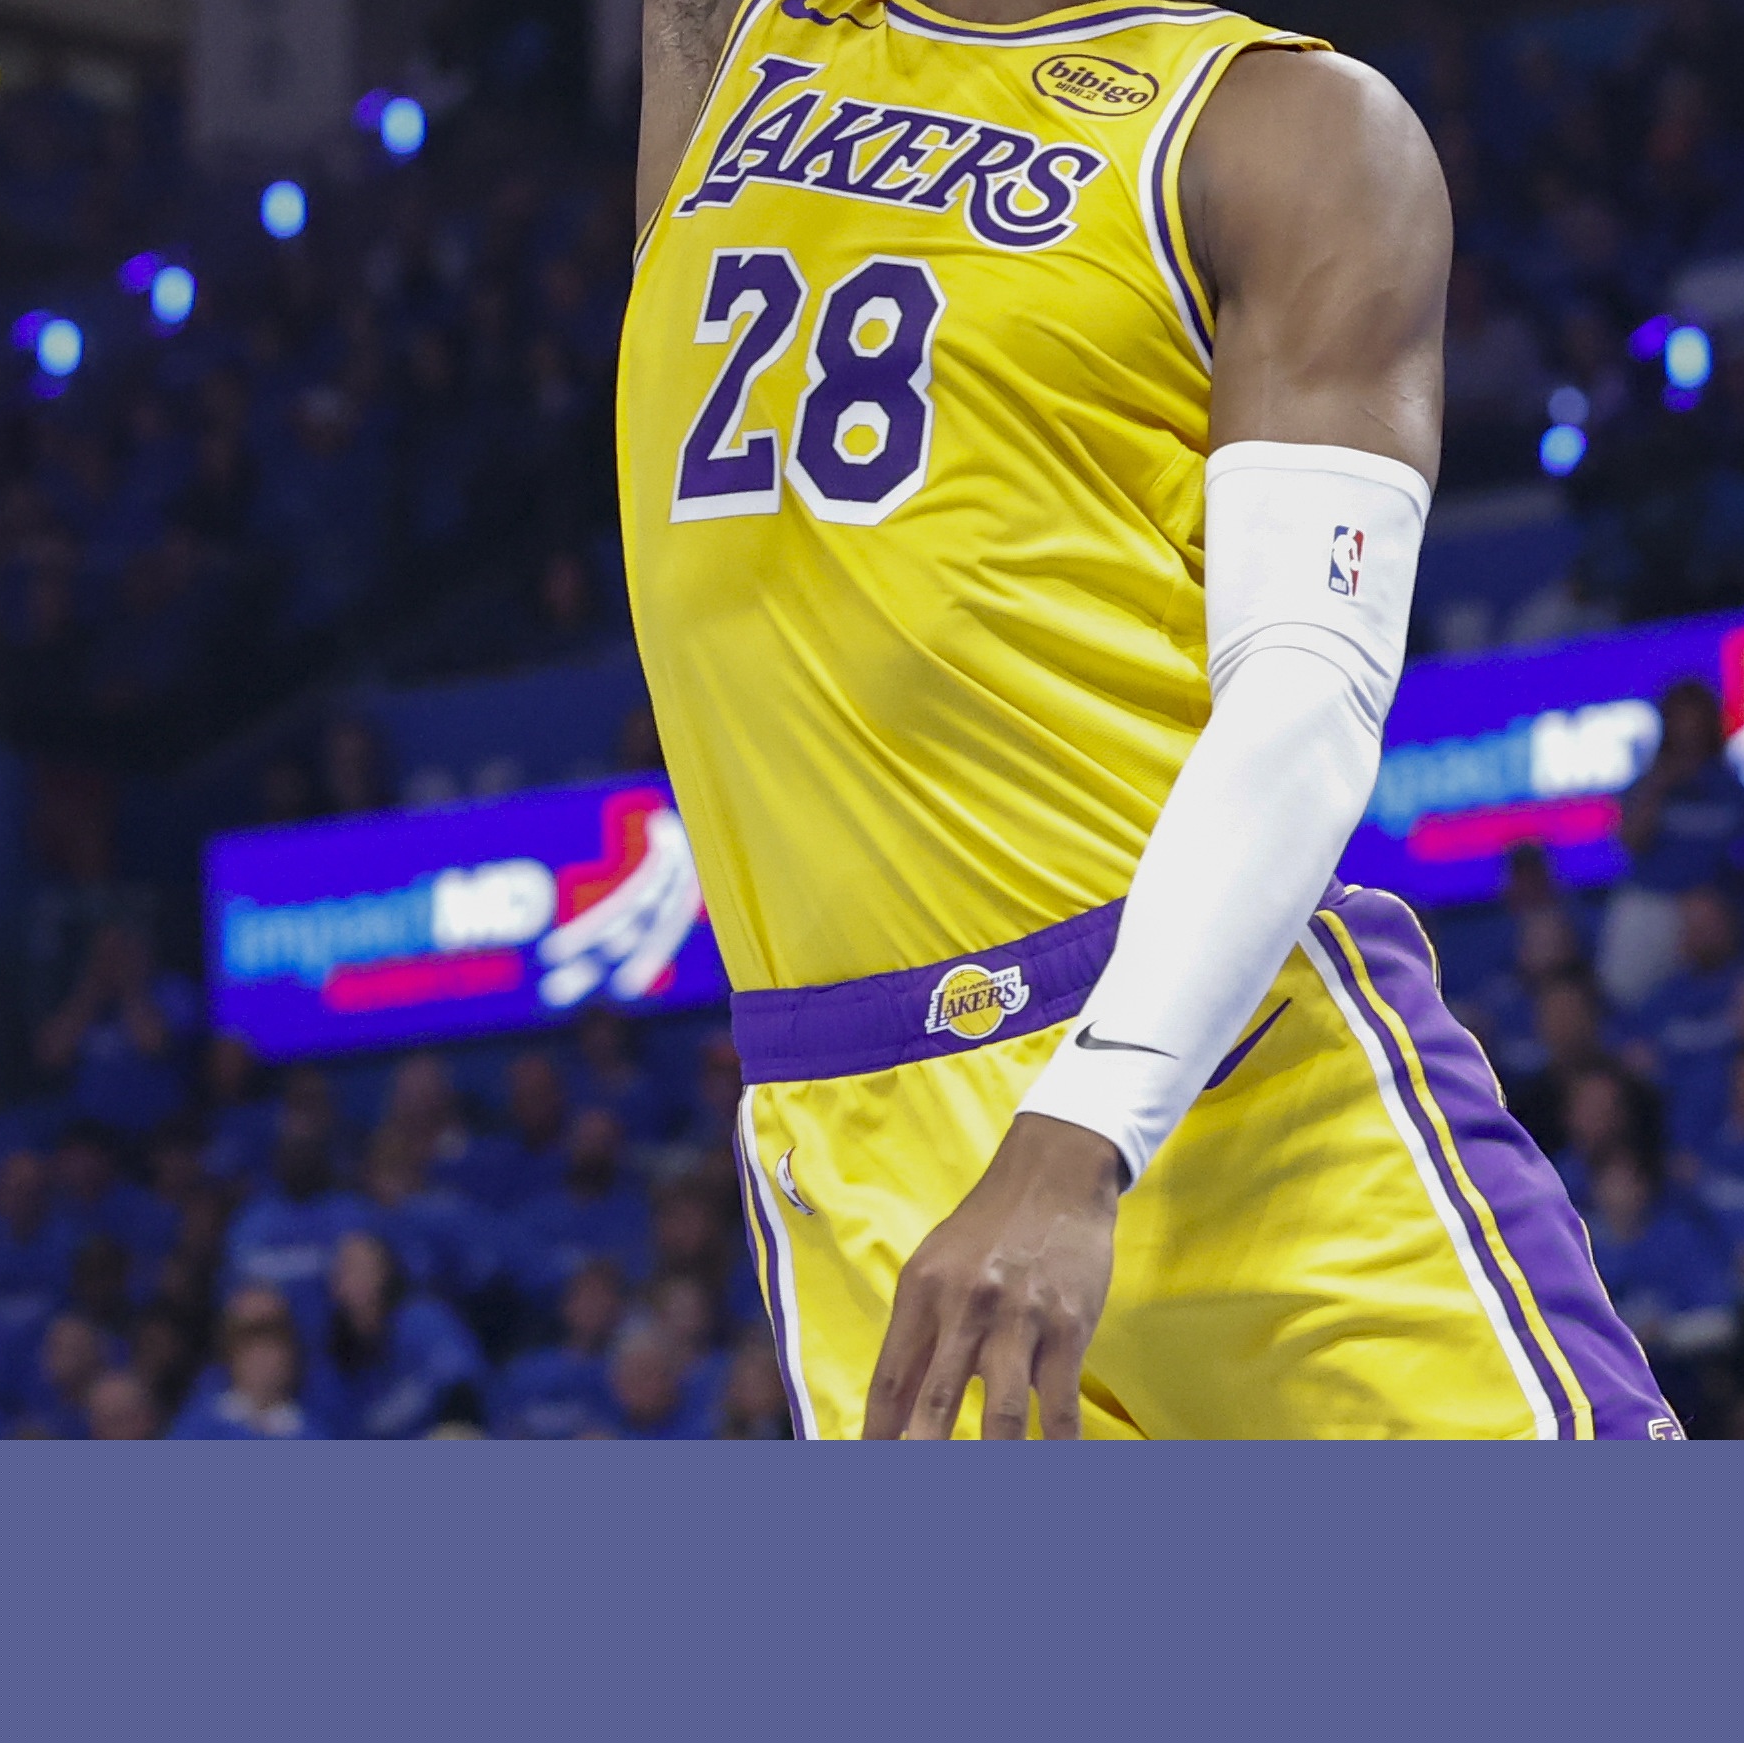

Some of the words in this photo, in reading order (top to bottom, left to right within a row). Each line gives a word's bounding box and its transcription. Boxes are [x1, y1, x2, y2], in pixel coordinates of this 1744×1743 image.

[1046, 60, 1150, 105] bibigo
[672, 53, 1110, 254] LAKERS
[669, 246, 948, 527] 28
[930, 980, 1026, 1030] LAKERS
